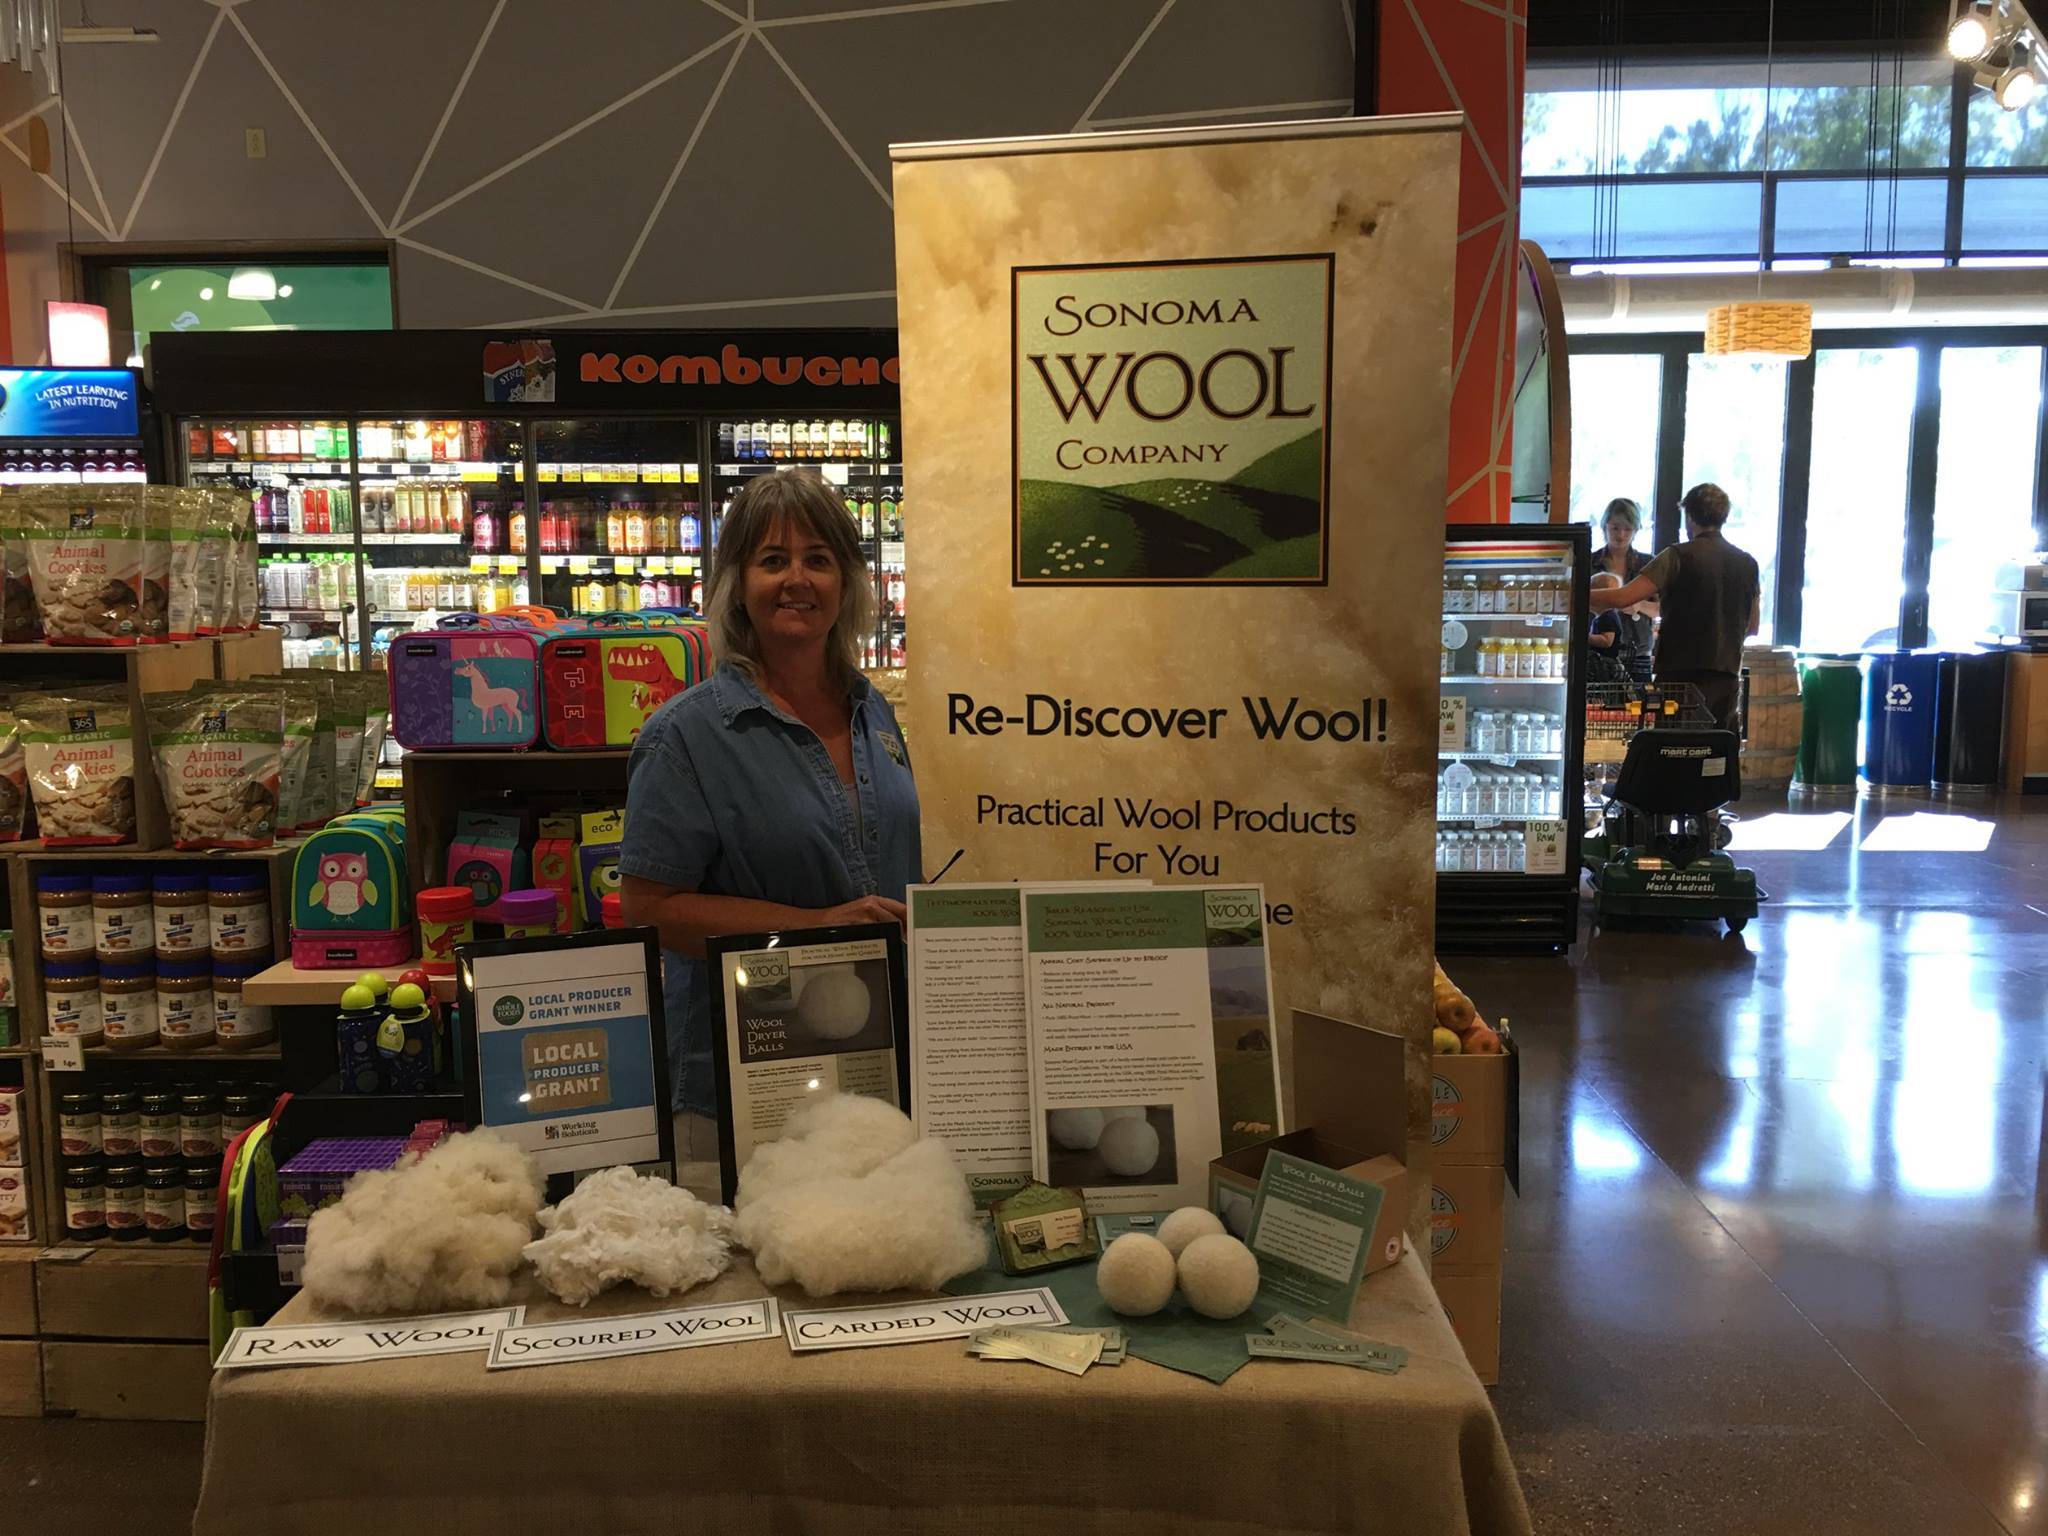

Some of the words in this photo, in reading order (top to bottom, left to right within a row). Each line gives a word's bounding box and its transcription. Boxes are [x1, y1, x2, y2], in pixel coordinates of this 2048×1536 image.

[1044, 295, 1259, 336] SONOMA
[1027, 346, 1317, 424] WOOL
[35, 385, 73, 402] LATEST
[76, 384, 129, 400] LEARNING
[48, 399, 62, 410] IN
[63, 397, 119, 410] NUTRITION
[1056, 440, 1230, 471] COMPANY
[53, 544, 106, 559] Animal
[48, 559, 107, 575] Cookies
[1884, 705, 1913, 713] RECYCLE
[74, 718, 93, 729] 365
[947, 693, 1228, 739] Re-Discover
[1241, 697, 1388, 743] Wool!
[59, 731, 111, 742] ORGANIC
[54, 745, 114, 761] Animal
[186, 747, 242, 762] Animal
[1660, 746, 1688, 756] mart
[183, 764, 246, 778] Cookies
[976, 795, 1103, 828] Practical
[1114, 798, 1201, 830] Wool
[1213, 801, 1356, 835] Products
[1529, 822, 1550, 832] 100
[1536, 832, 1557, 842] RAW
[1095, 843, 1148, 874] For
[1157, 845, 1219, 877] You
[1207, 904, 1259, 918] WOOL
[1043, 919, 1088, 929] SONOMA
[1092, 917, 1121, 927] WOOL
[1074, 929, 1102, 938] WOOL
[1138, 927, 1167, 937] BALLS
[528, 994, 565, 1007] LOCAL
[568, 987, 632, 1002] PRODUCER
[529, 1007, 568, 1020] GRANT
[572, 1001, 621, 1015] WINNER
[745, 1018, 786, 1031] WOOL
[747, 1030, 788, 1043] DRYER
[533, 1041, 599, 1065] LOCAL
[747, 1043, 785, 1056] BALLS
[533, 1063, 600, 1079] PRODUCER
[535, 1077, 601, 1098] GRANT
[560, 1121, 597, 1132] Working
[560, 1128, 599, 1139] Solutions
[972, 1176, 1021, 1188] SONOMA
[1281, 1163, 1306, 1179] WOOL
[1308, 1171, 1338, 1191] DRYER
[1337, 1182, 1366, 1199] BALLS
[798, 1316, 936, 1339] CARDED
[941, 1304, 1046, 1325] WOOL
[245, 1337, 346, 1356] RAW
[364, 1325, 494, 1349] WOOL
[503, 1328, 657, 1356] SCOURED
[664, 1315, 762, 1336] WOOL
